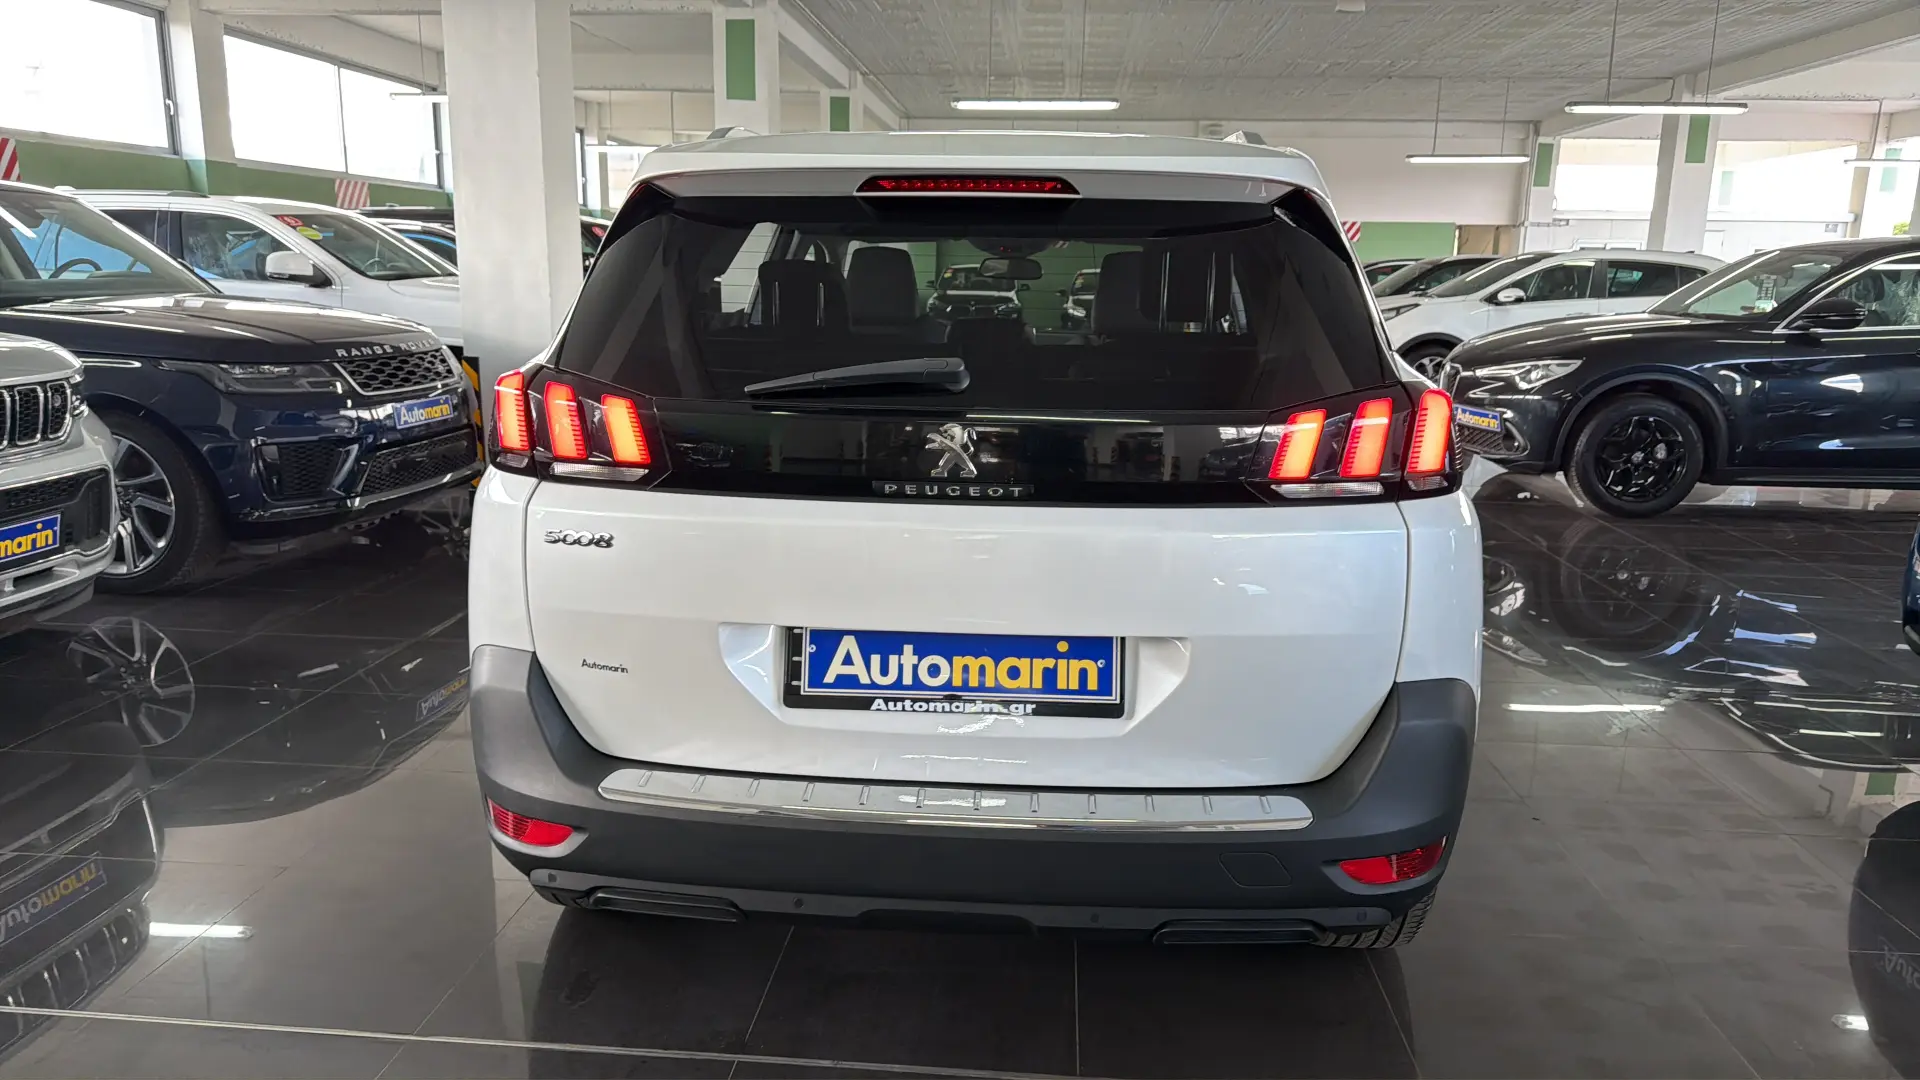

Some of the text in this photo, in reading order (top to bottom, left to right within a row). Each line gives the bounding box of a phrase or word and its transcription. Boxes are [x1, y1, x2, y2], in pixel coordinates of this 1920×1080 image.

[336, 344, 393, 357] RANGE
[400, 399, 450, 424] Automarin
[1457, 407, 1497, 429] Automarin
[884, 483, 1023, 497] PEUGEOT
[544, 529, 615, 548] 5008
[581, 658, 629, 673] Automarin
[823, 635, 1098, 691] Automarin
[870, 698, 1036, 716] Automarin.gr
